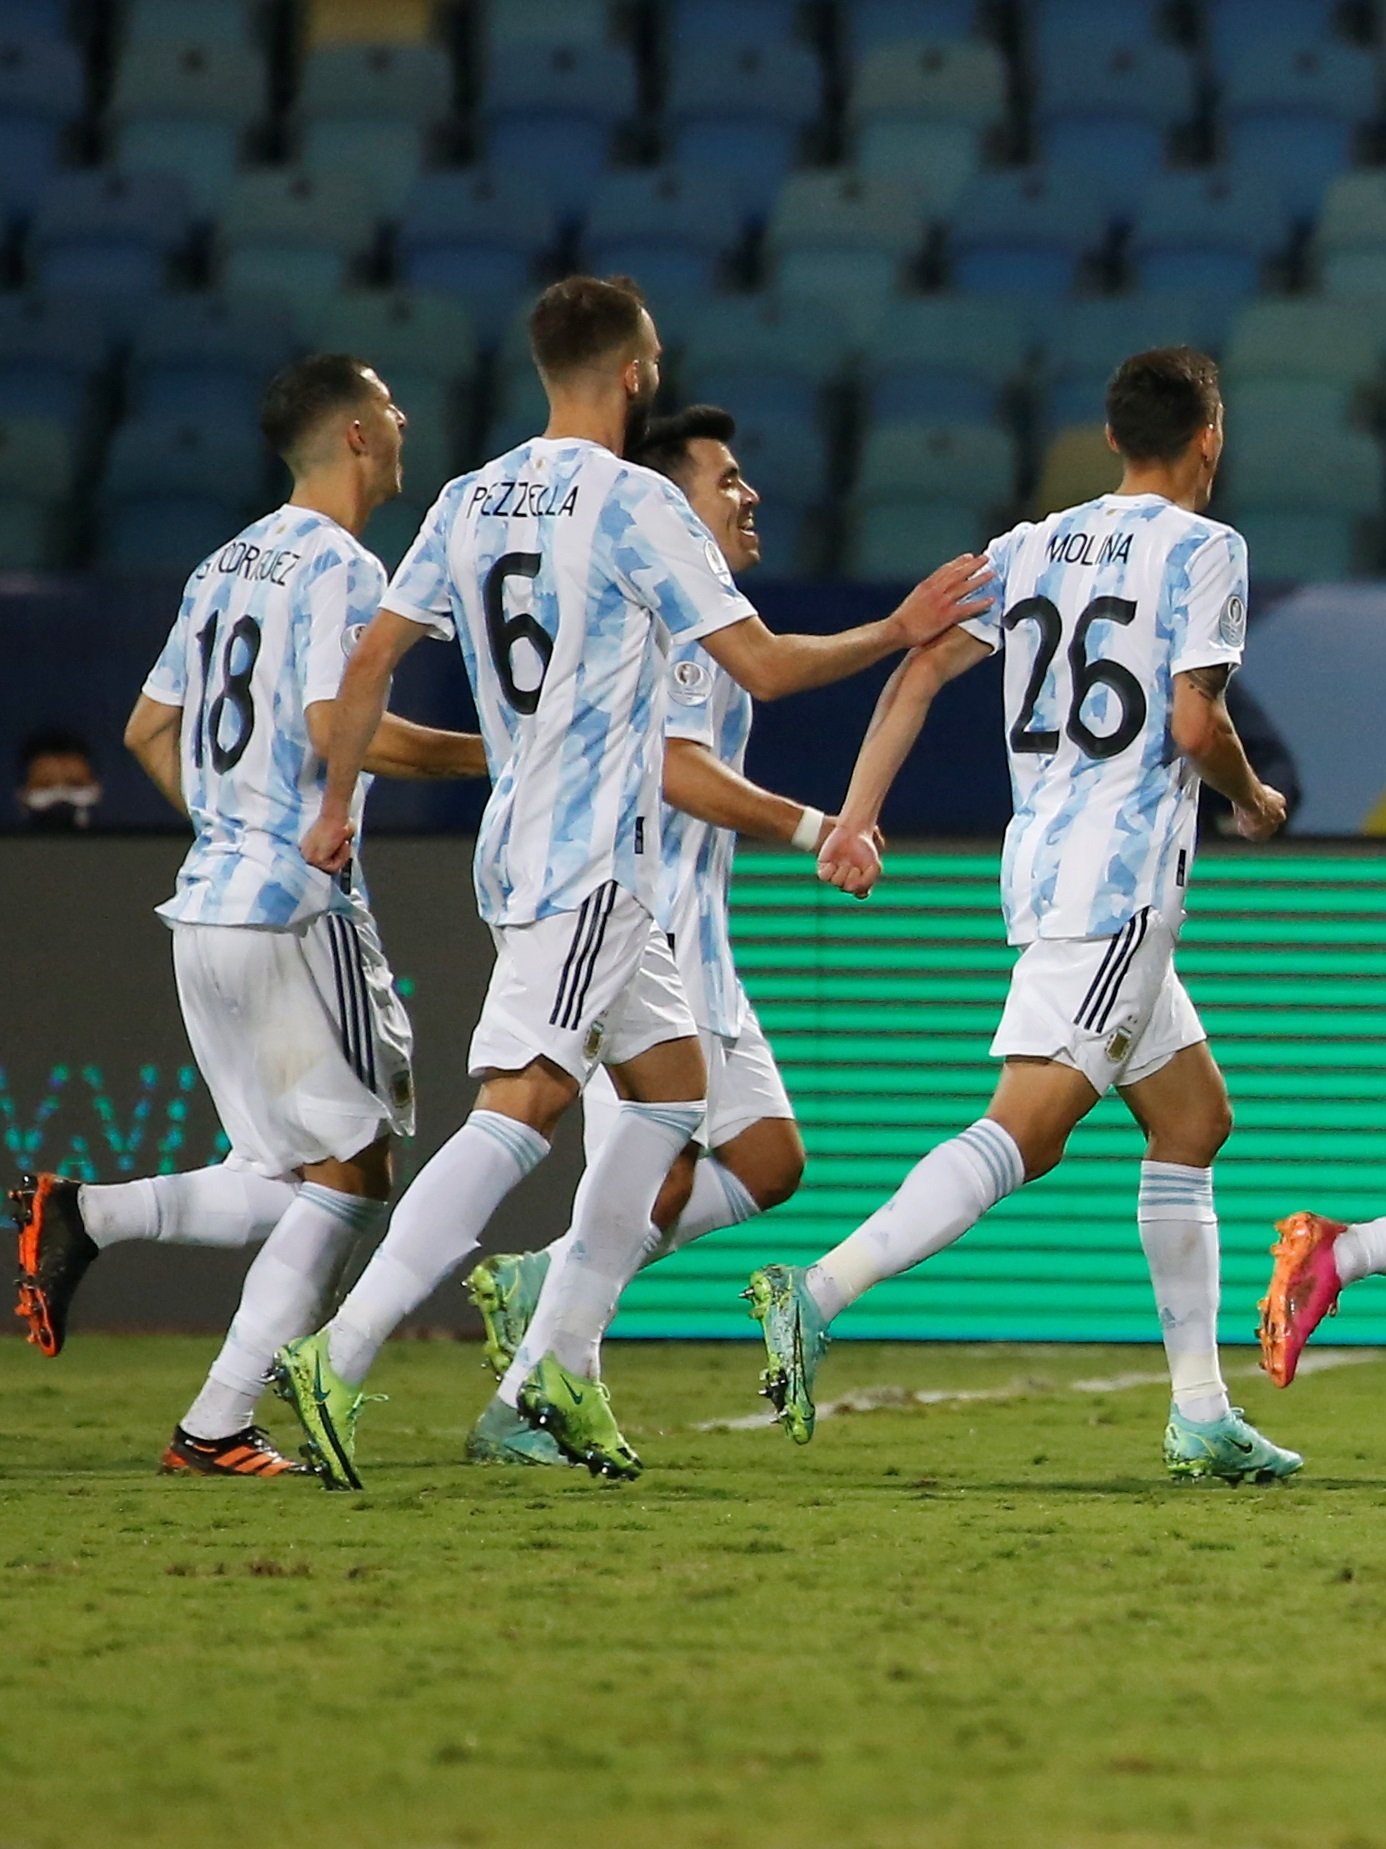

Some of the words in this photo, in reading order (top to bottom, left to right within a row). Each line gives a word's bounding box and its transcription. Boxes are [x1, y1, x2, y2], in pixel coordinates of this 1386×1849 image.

[467, 482, 579, 518] PEZZELLA
[1047, 533, 1134, 566] MOLINA
[195, 608, 262, 776] 18
[482, 551, 554, 716] 6
[1003, 595, 1147, 760] 26
